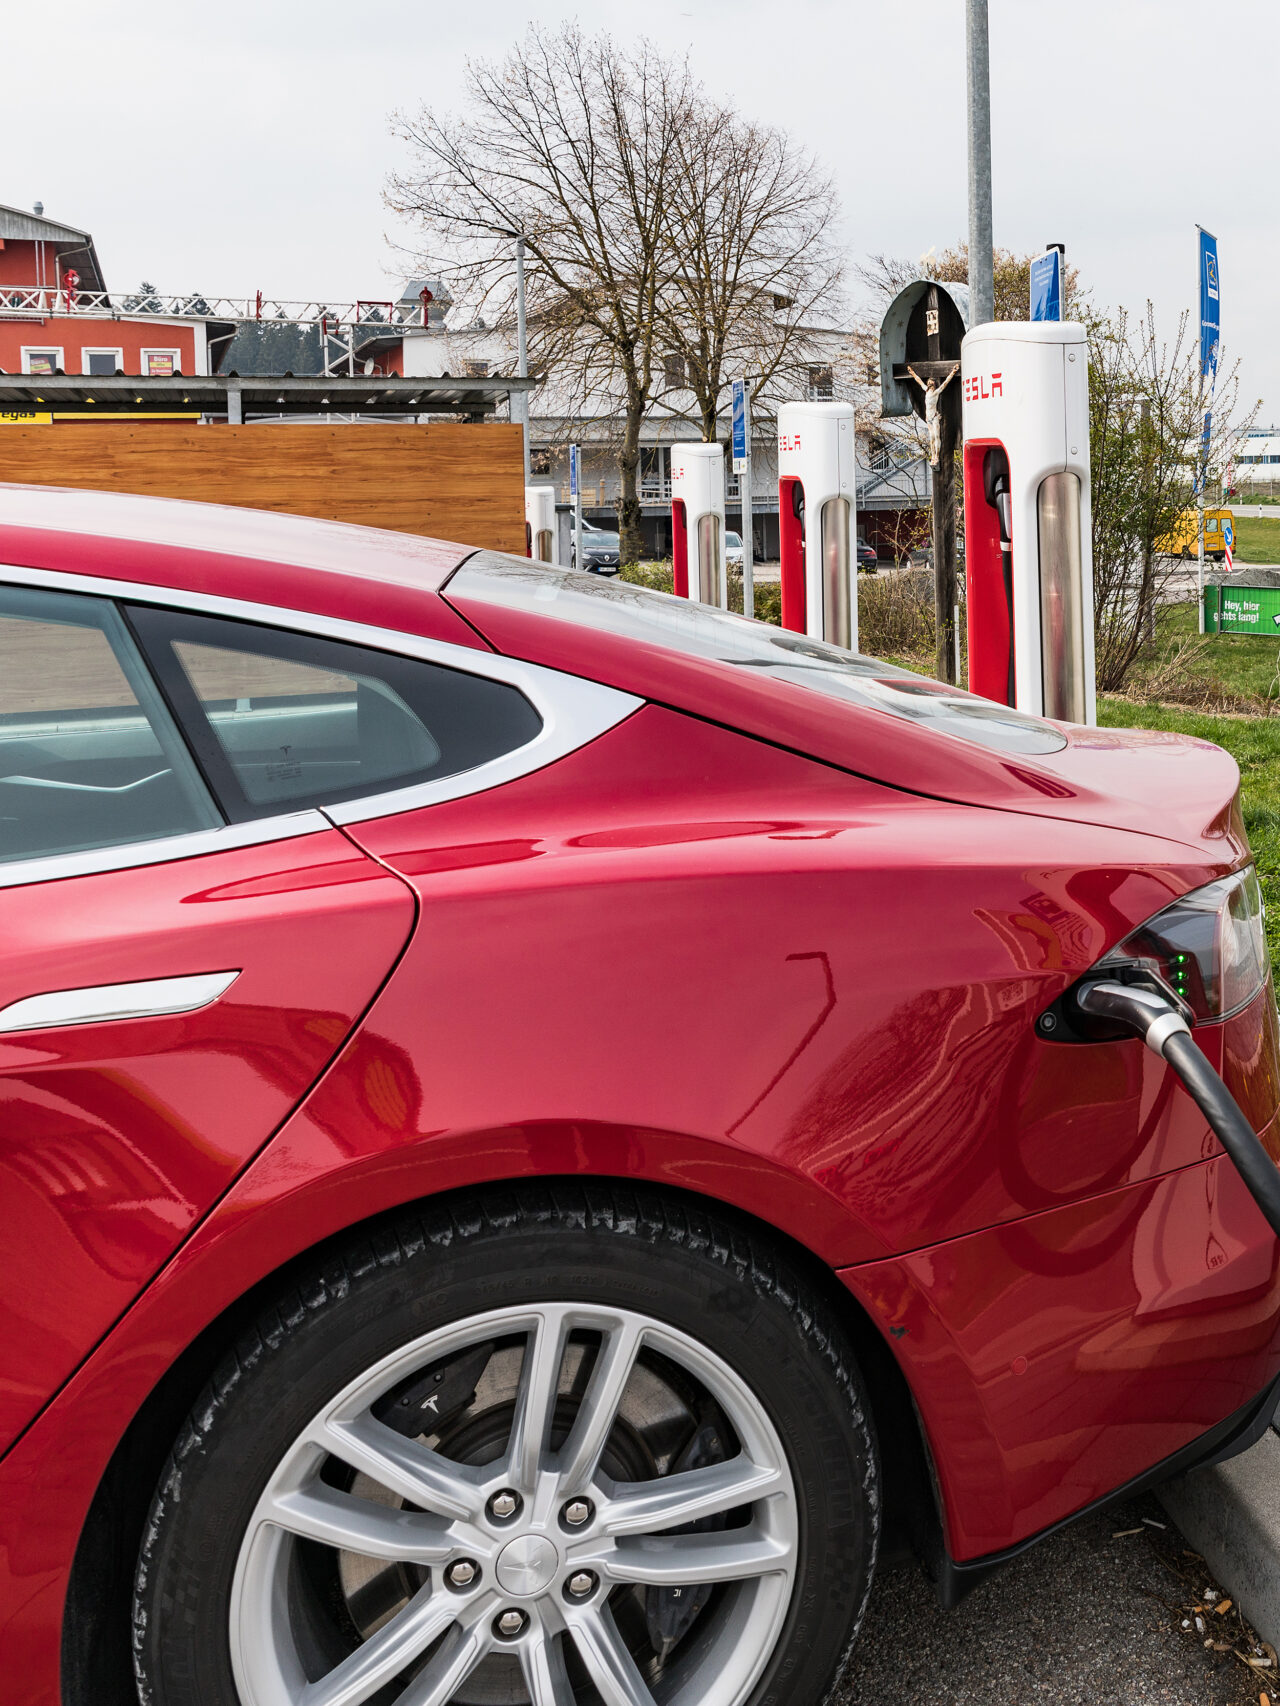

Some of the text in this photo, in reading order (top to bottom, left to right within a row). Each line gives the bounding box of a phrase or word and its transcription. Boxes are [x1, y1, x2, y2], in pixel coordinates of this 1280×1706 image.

[962, 372, 1003, 402] ESLA
[779, 435, 801, 451] ESLA
[1224, 600, 1260, 612] Hey, hier
[1238, 612, 1260, 624] lang!
